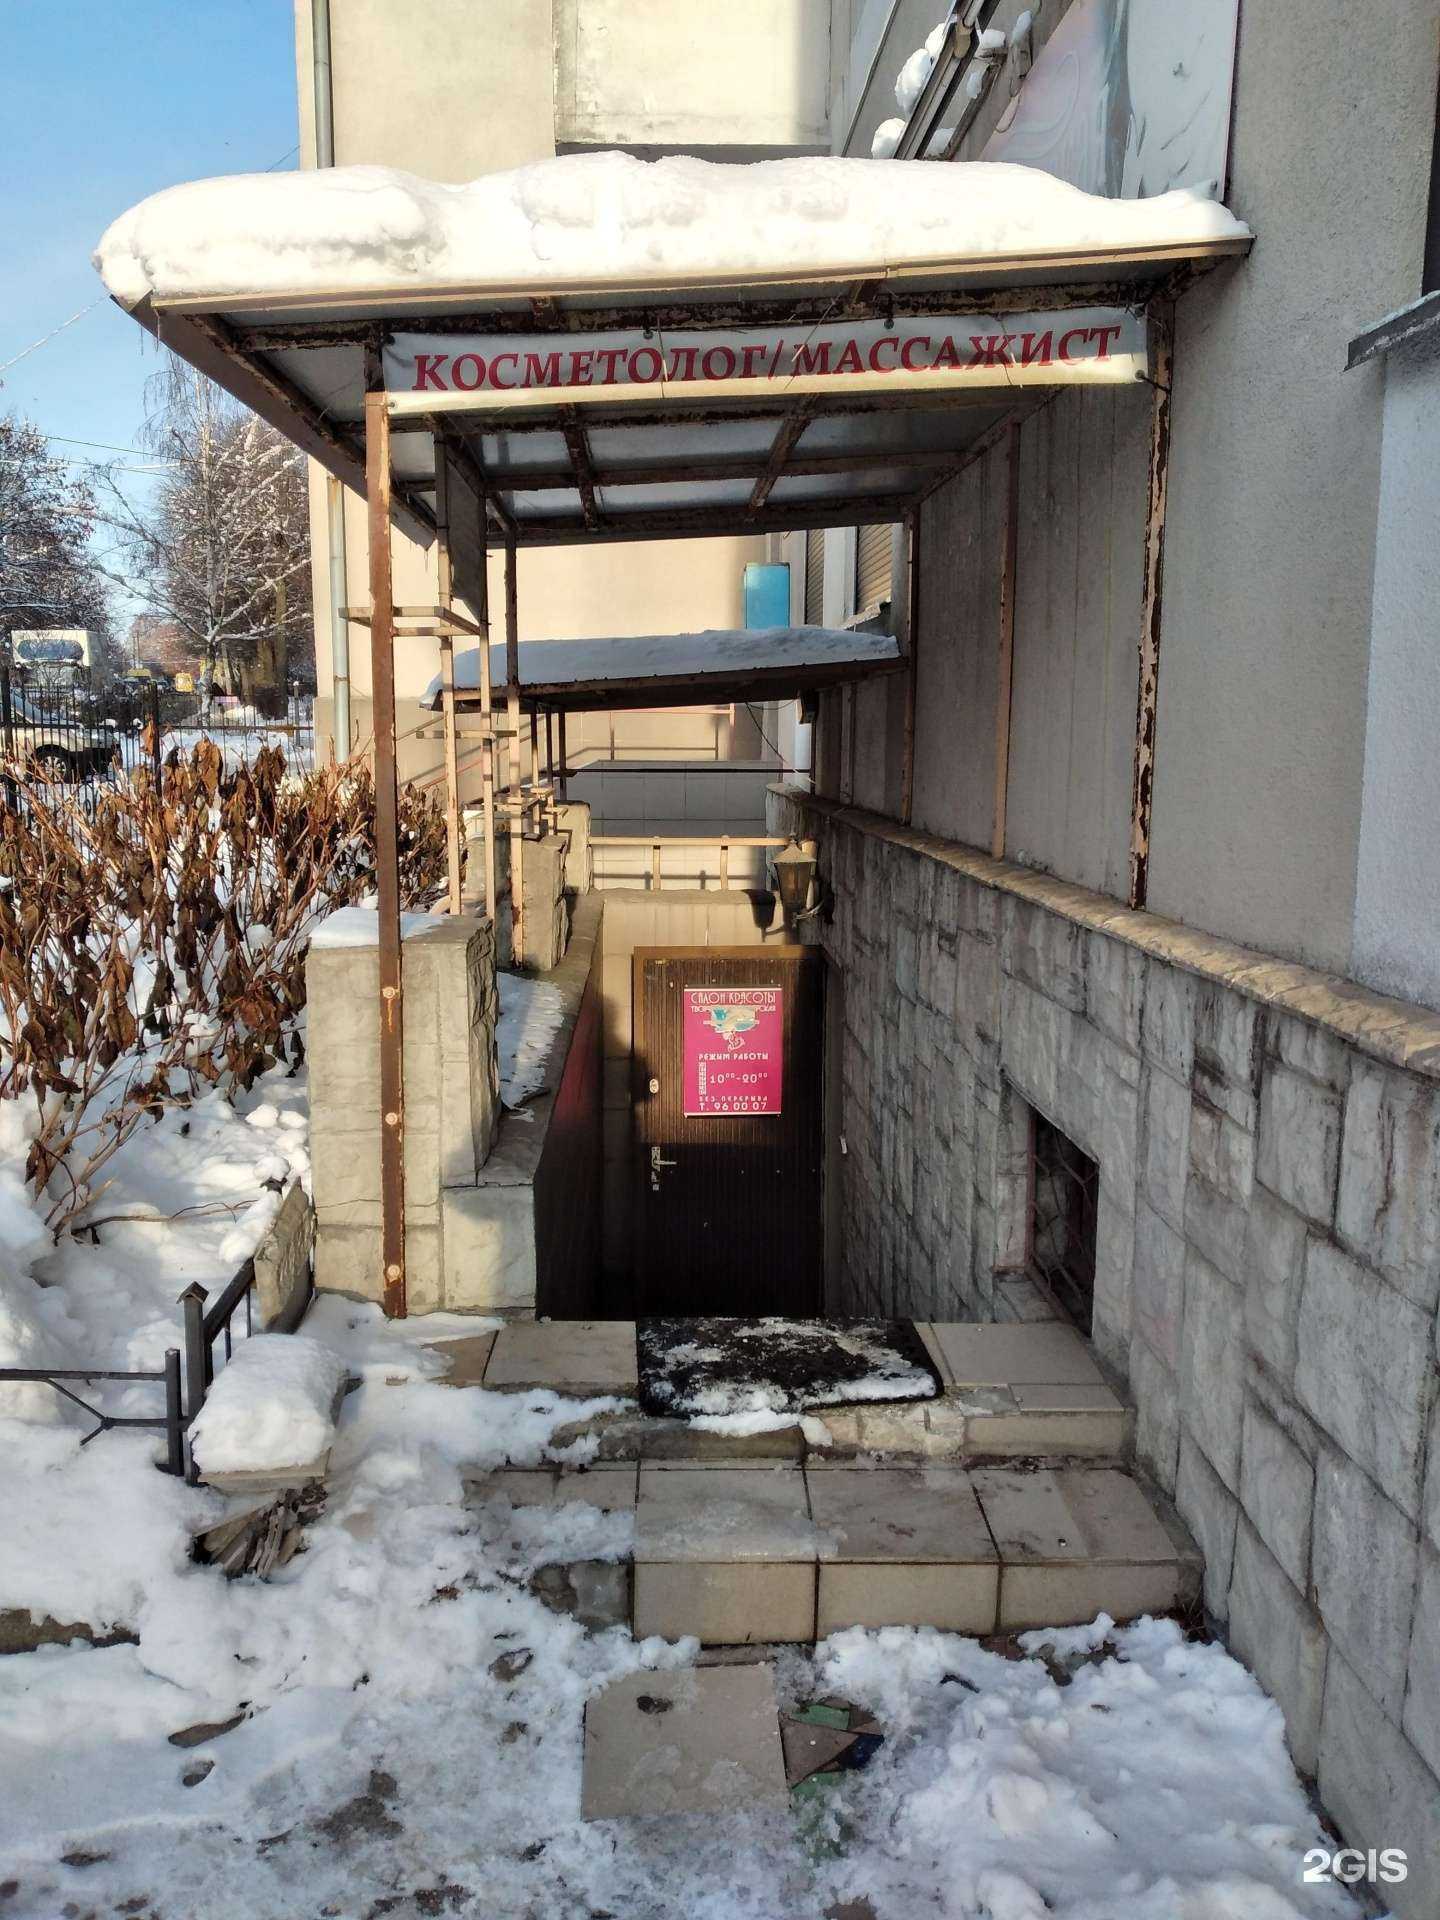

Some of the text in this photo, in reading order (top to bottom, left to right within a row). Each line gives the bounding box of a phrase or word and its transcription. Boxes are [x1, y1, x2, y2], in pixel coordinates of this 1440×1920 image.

[411, 325, 1122, 392] КОСМЕТОЛОГ/МАССАЖИСТ
[691, 991, 776, 1004] САЛОН КРАСОТЫ
